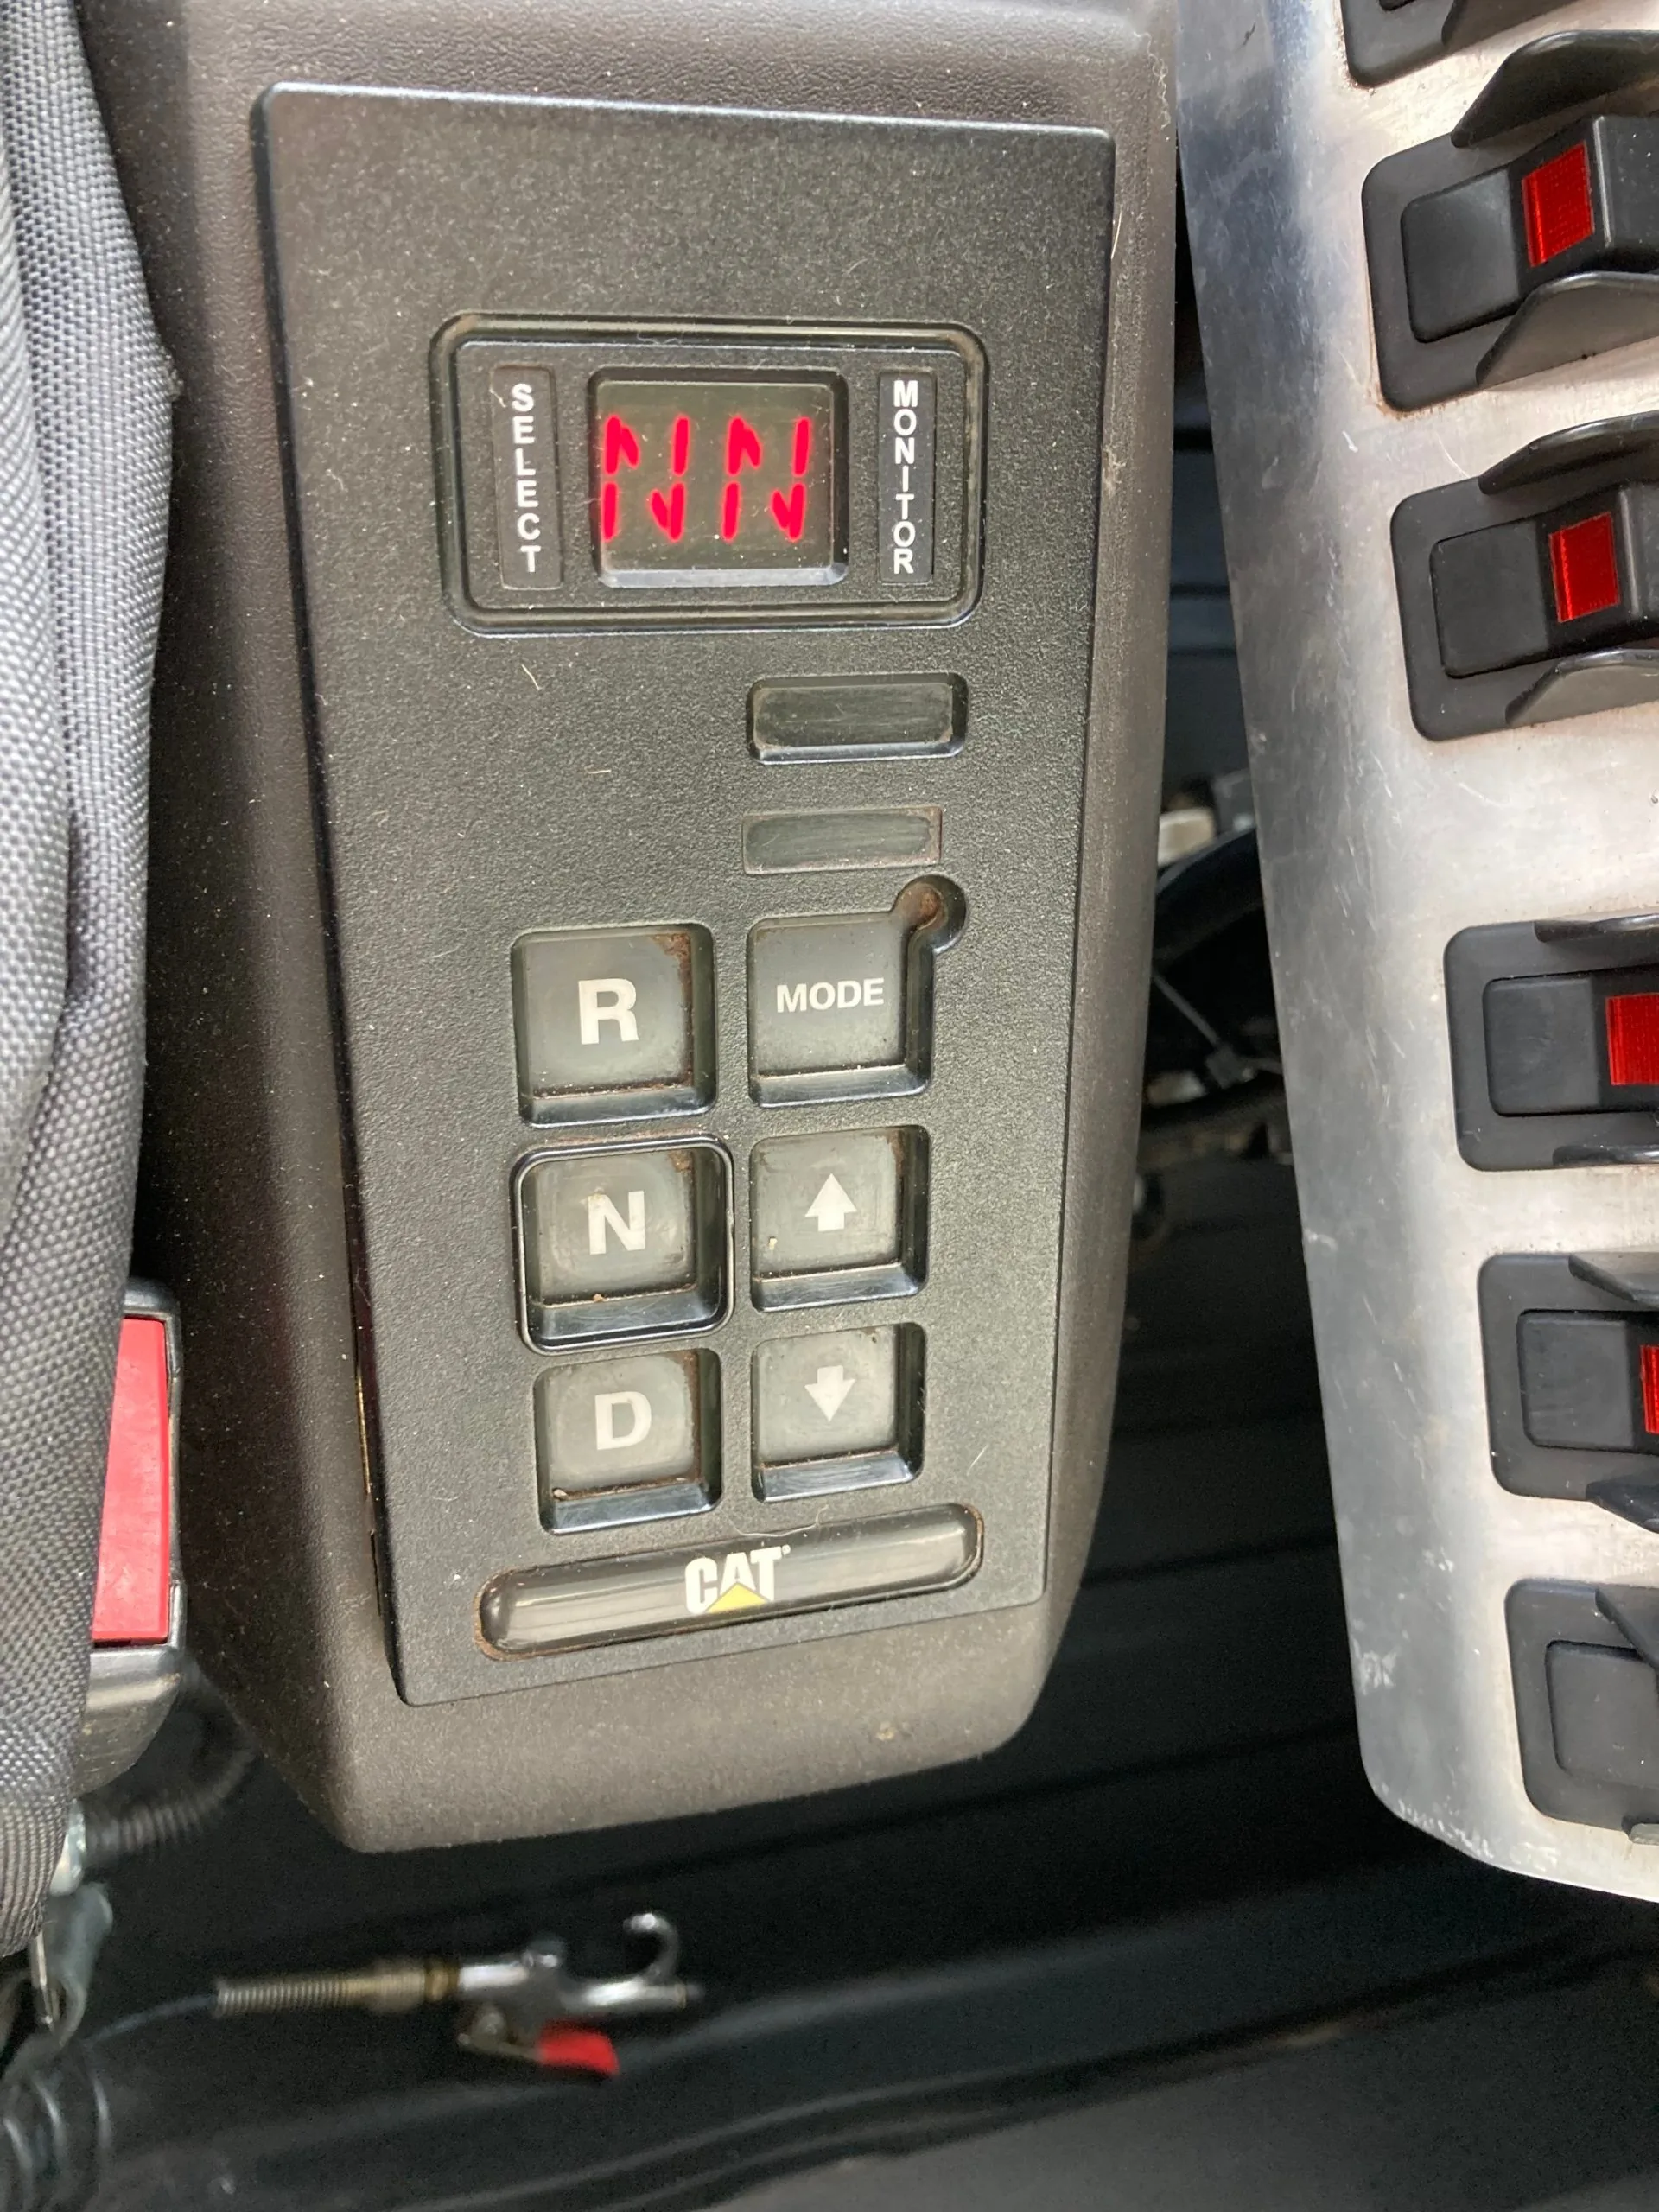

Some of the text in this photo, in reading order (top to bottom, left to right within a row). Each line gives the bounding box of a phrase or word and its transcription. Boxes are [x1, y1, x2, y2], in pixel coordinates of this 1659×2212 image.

[508, 383, 543, 574] SELECT
[892, 380, 918, 575] MONITOR
[577, 977, 640, 1046] R
[776, 977, 886, 1014] MODE
[586, 1190, 648, 1255] N
[594, 1390, 652, 1451] D
